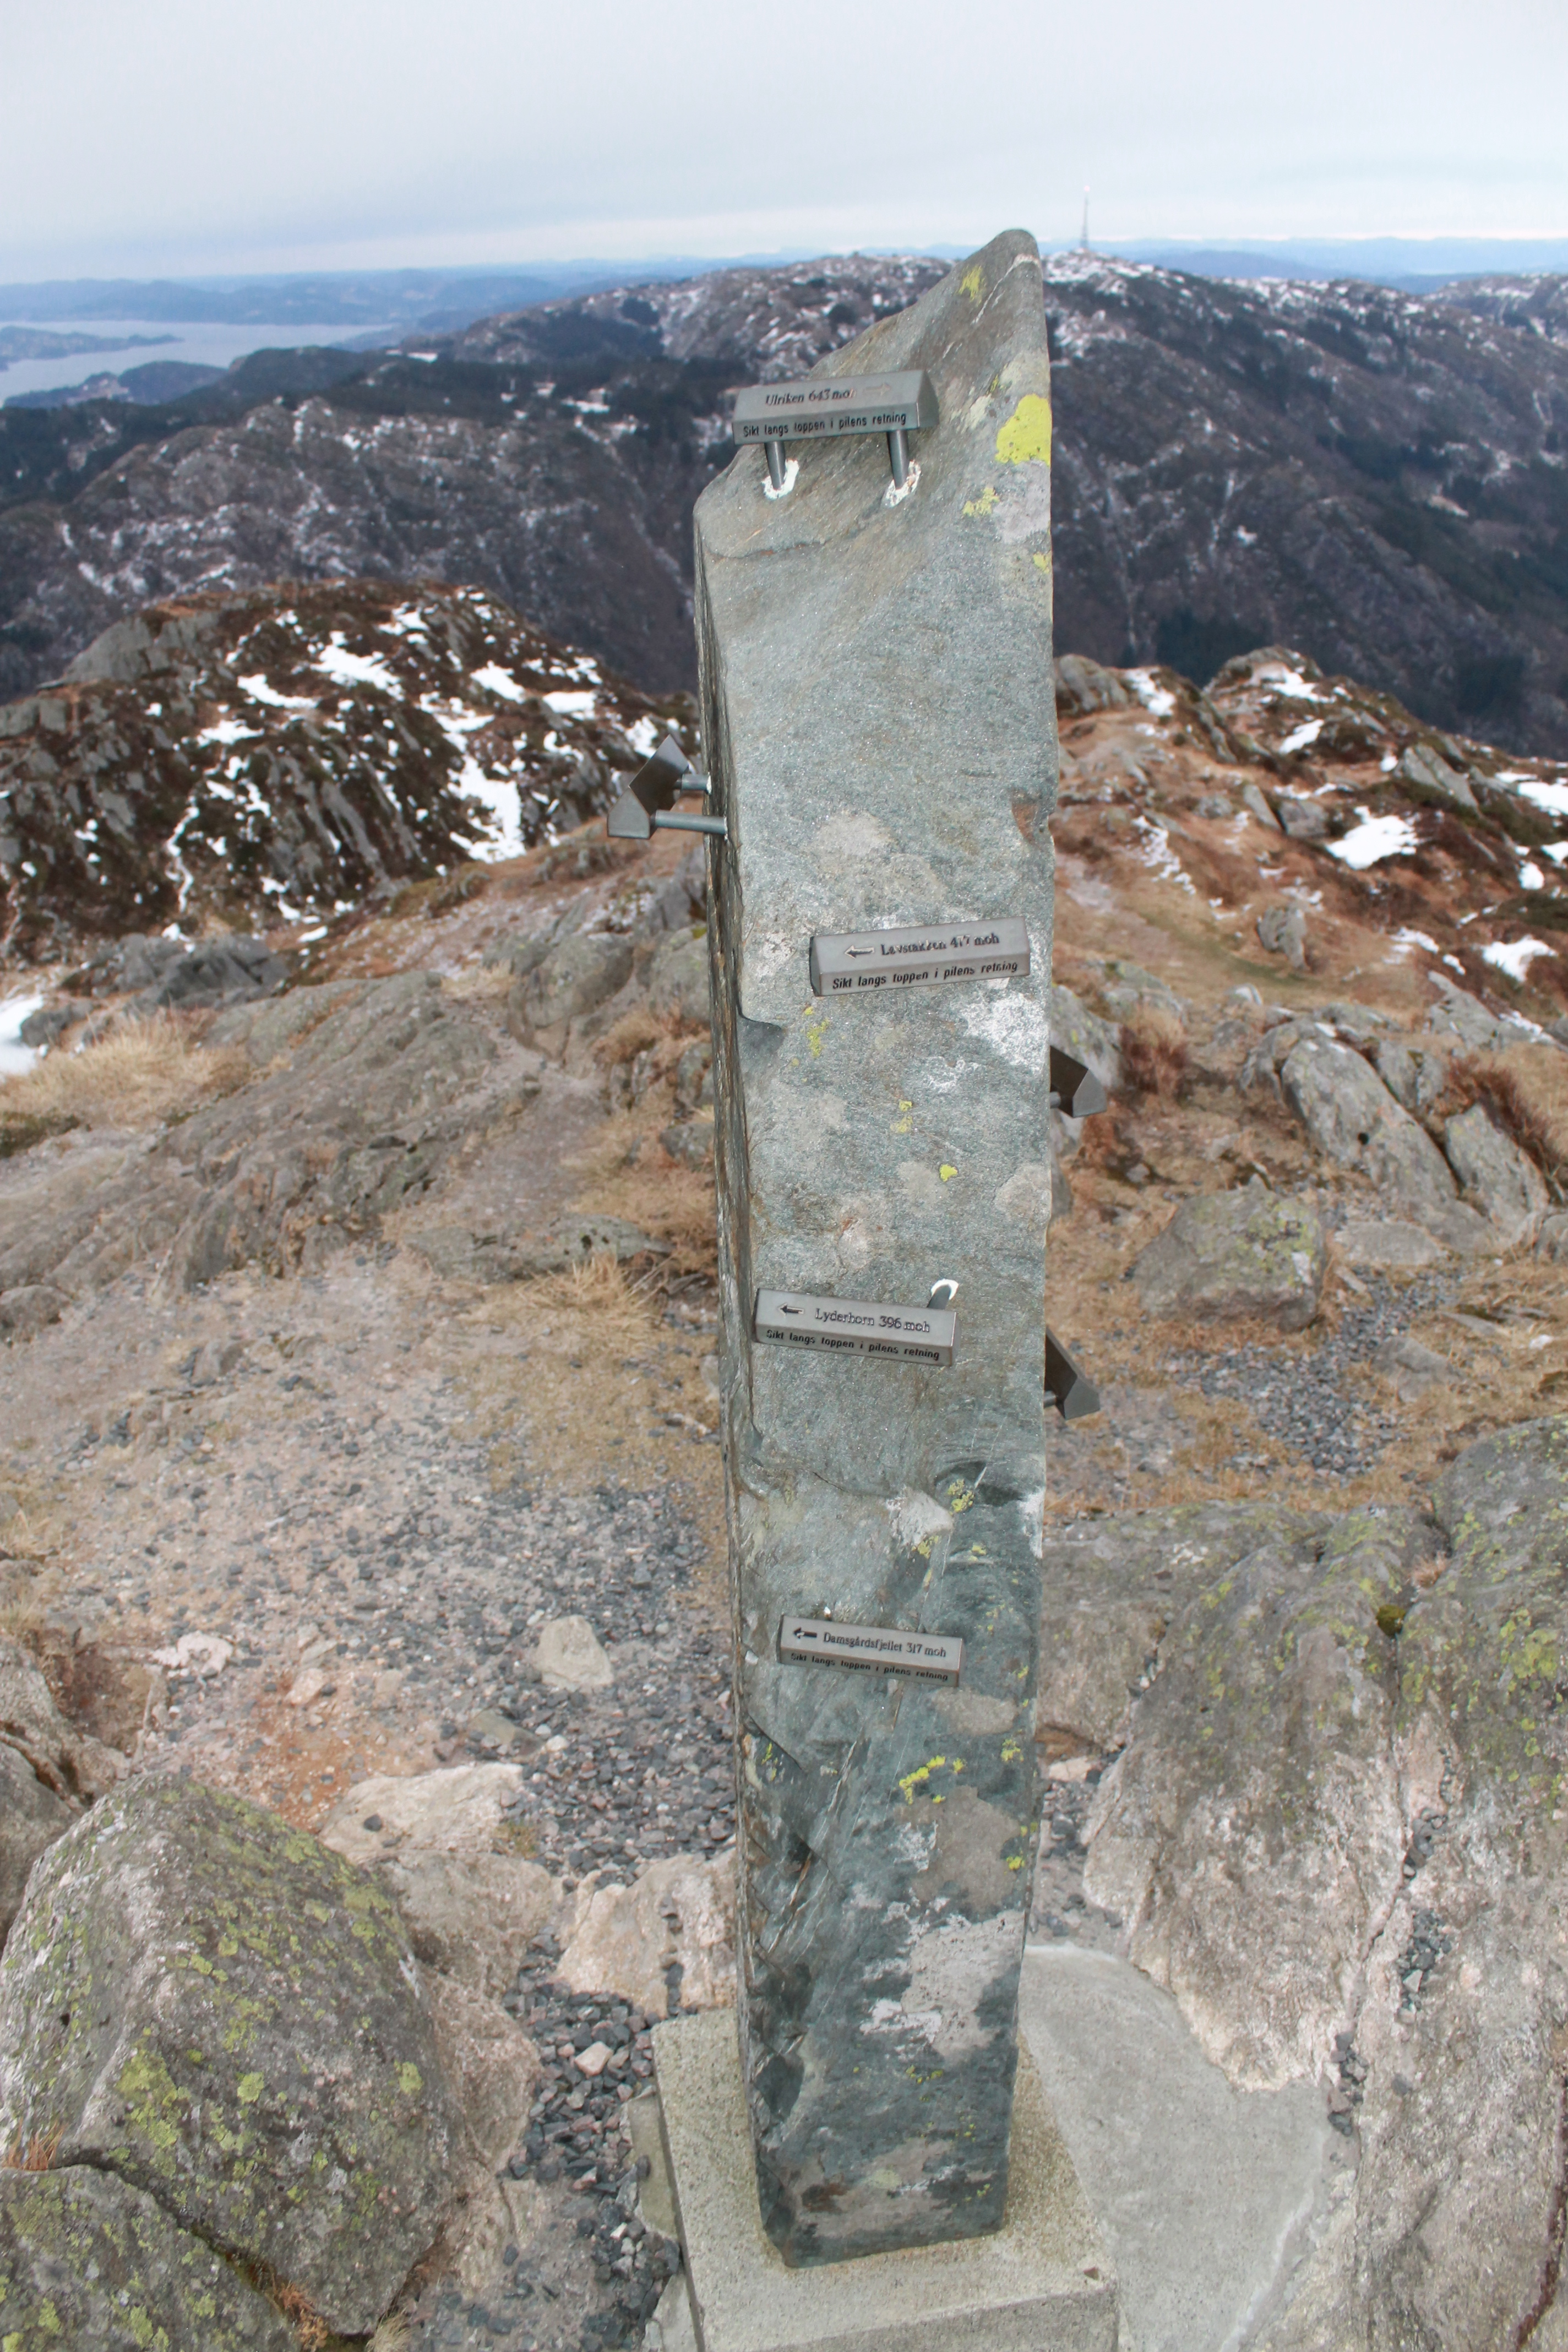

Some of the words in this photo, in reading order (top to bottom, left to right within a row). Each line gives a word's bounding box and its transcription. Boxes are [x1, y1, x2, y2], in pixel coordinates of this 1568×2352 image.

[765, 391, 804, 406] Ulriken
[809, 389, 830, 401] 643
[743, 424, 759, 437] Sikt
[765, 423, 788, 437] langs
[794, 420, 825, 434] toppen
[830, 419, 834, 428] i
[839, 415, 867, 429] pilens
[872, 412, 906, 425] retning
[950, 935, 970, 948] 477
[974, 933, 999, 946] moh
[832, 978, 852, 989] Sikt
[858, 974, 886, 988] langs
[893, 971, 928, 984] toppen
[934, 968, 938, 978] i
[944, 965, 974, 980] pilens
[981, 961, 1017, 973] retning
[815, 1308, 874, 1326] Lyderhorn
[879, 1315, 901, 1329] 396
[903, 1321, 929, 1332] moh
[766, 1330, 784, 1340] Sikt
[790, 1333, 815, 1344] langs
[821, 1337, 854, 1349] toppen
[869, 1343, 899, 1354] pilens
[904, 1347, 939, 1360] retning
[824, 1632, 902, 1652] Damsgårdsfjellet
[906, 1642, 922, 1653] 317
[924, 1647, 946, 1657] moh
[791, 1653, 806, 1662] Sikt
[812, 1656, 835, 1666] langs
[841, 1660, 870, 1671] toppen
[884, 1667, 911, 1676] pilens
[916, 1670, 948, 1681] retning
